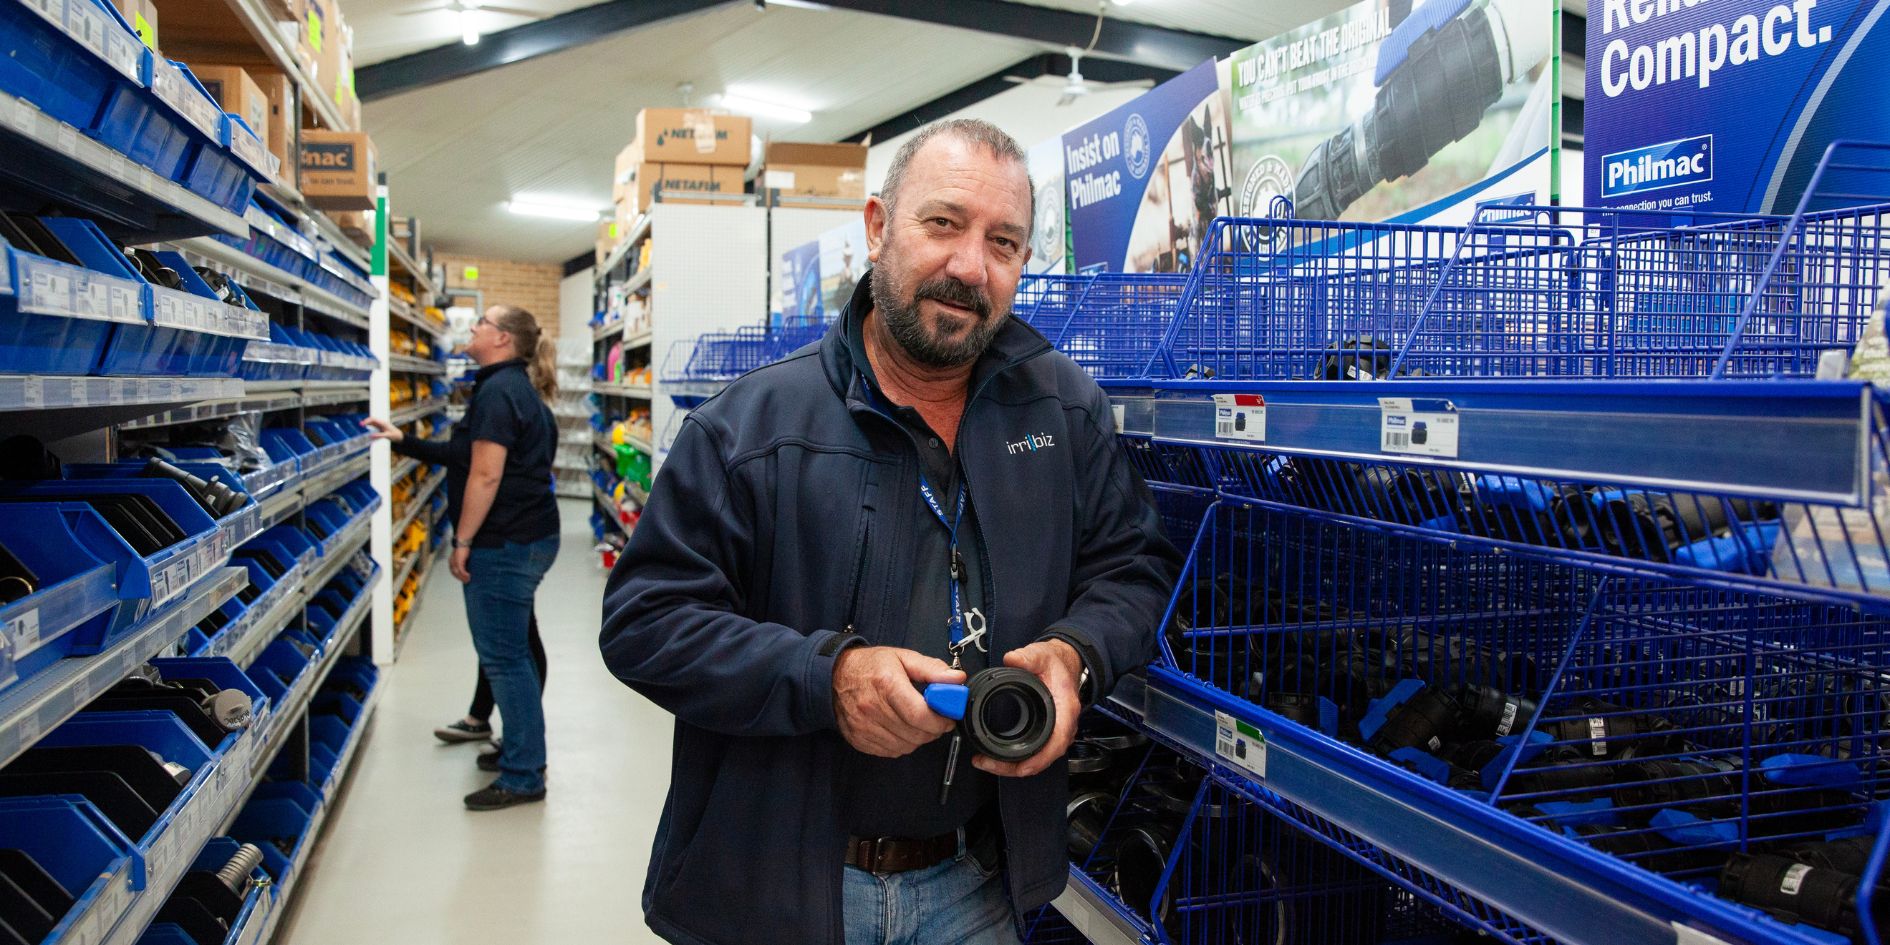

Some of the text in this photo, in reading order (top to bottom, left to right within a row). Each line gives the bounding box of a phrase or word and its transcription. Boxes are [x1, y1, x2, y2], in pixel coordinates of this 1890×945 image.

[1238, 58, 1257, 88] YOU
[1257, 46, 1289, 82] CAN'T
[1289, 34, 1317, 70] BEAT
[1319, 26, 1340, 59] THE
[1341, 7, 1392, 53] ORIGINAL
[1601, 0, 1832, 98] Compact.
[1067, 134, 1101, 175] Insist
[1102, 131, 1120, 159] on
[1608, 152, 1704, 188] Philmac
[1070, 169, 1121, 210] Philmac
[1658, 198, 1672, 211] you
[1675, 195, 1690, 206] can
[1691, 190, 1714, 204] trust.
[920, 484, 943, 516] STAFF
